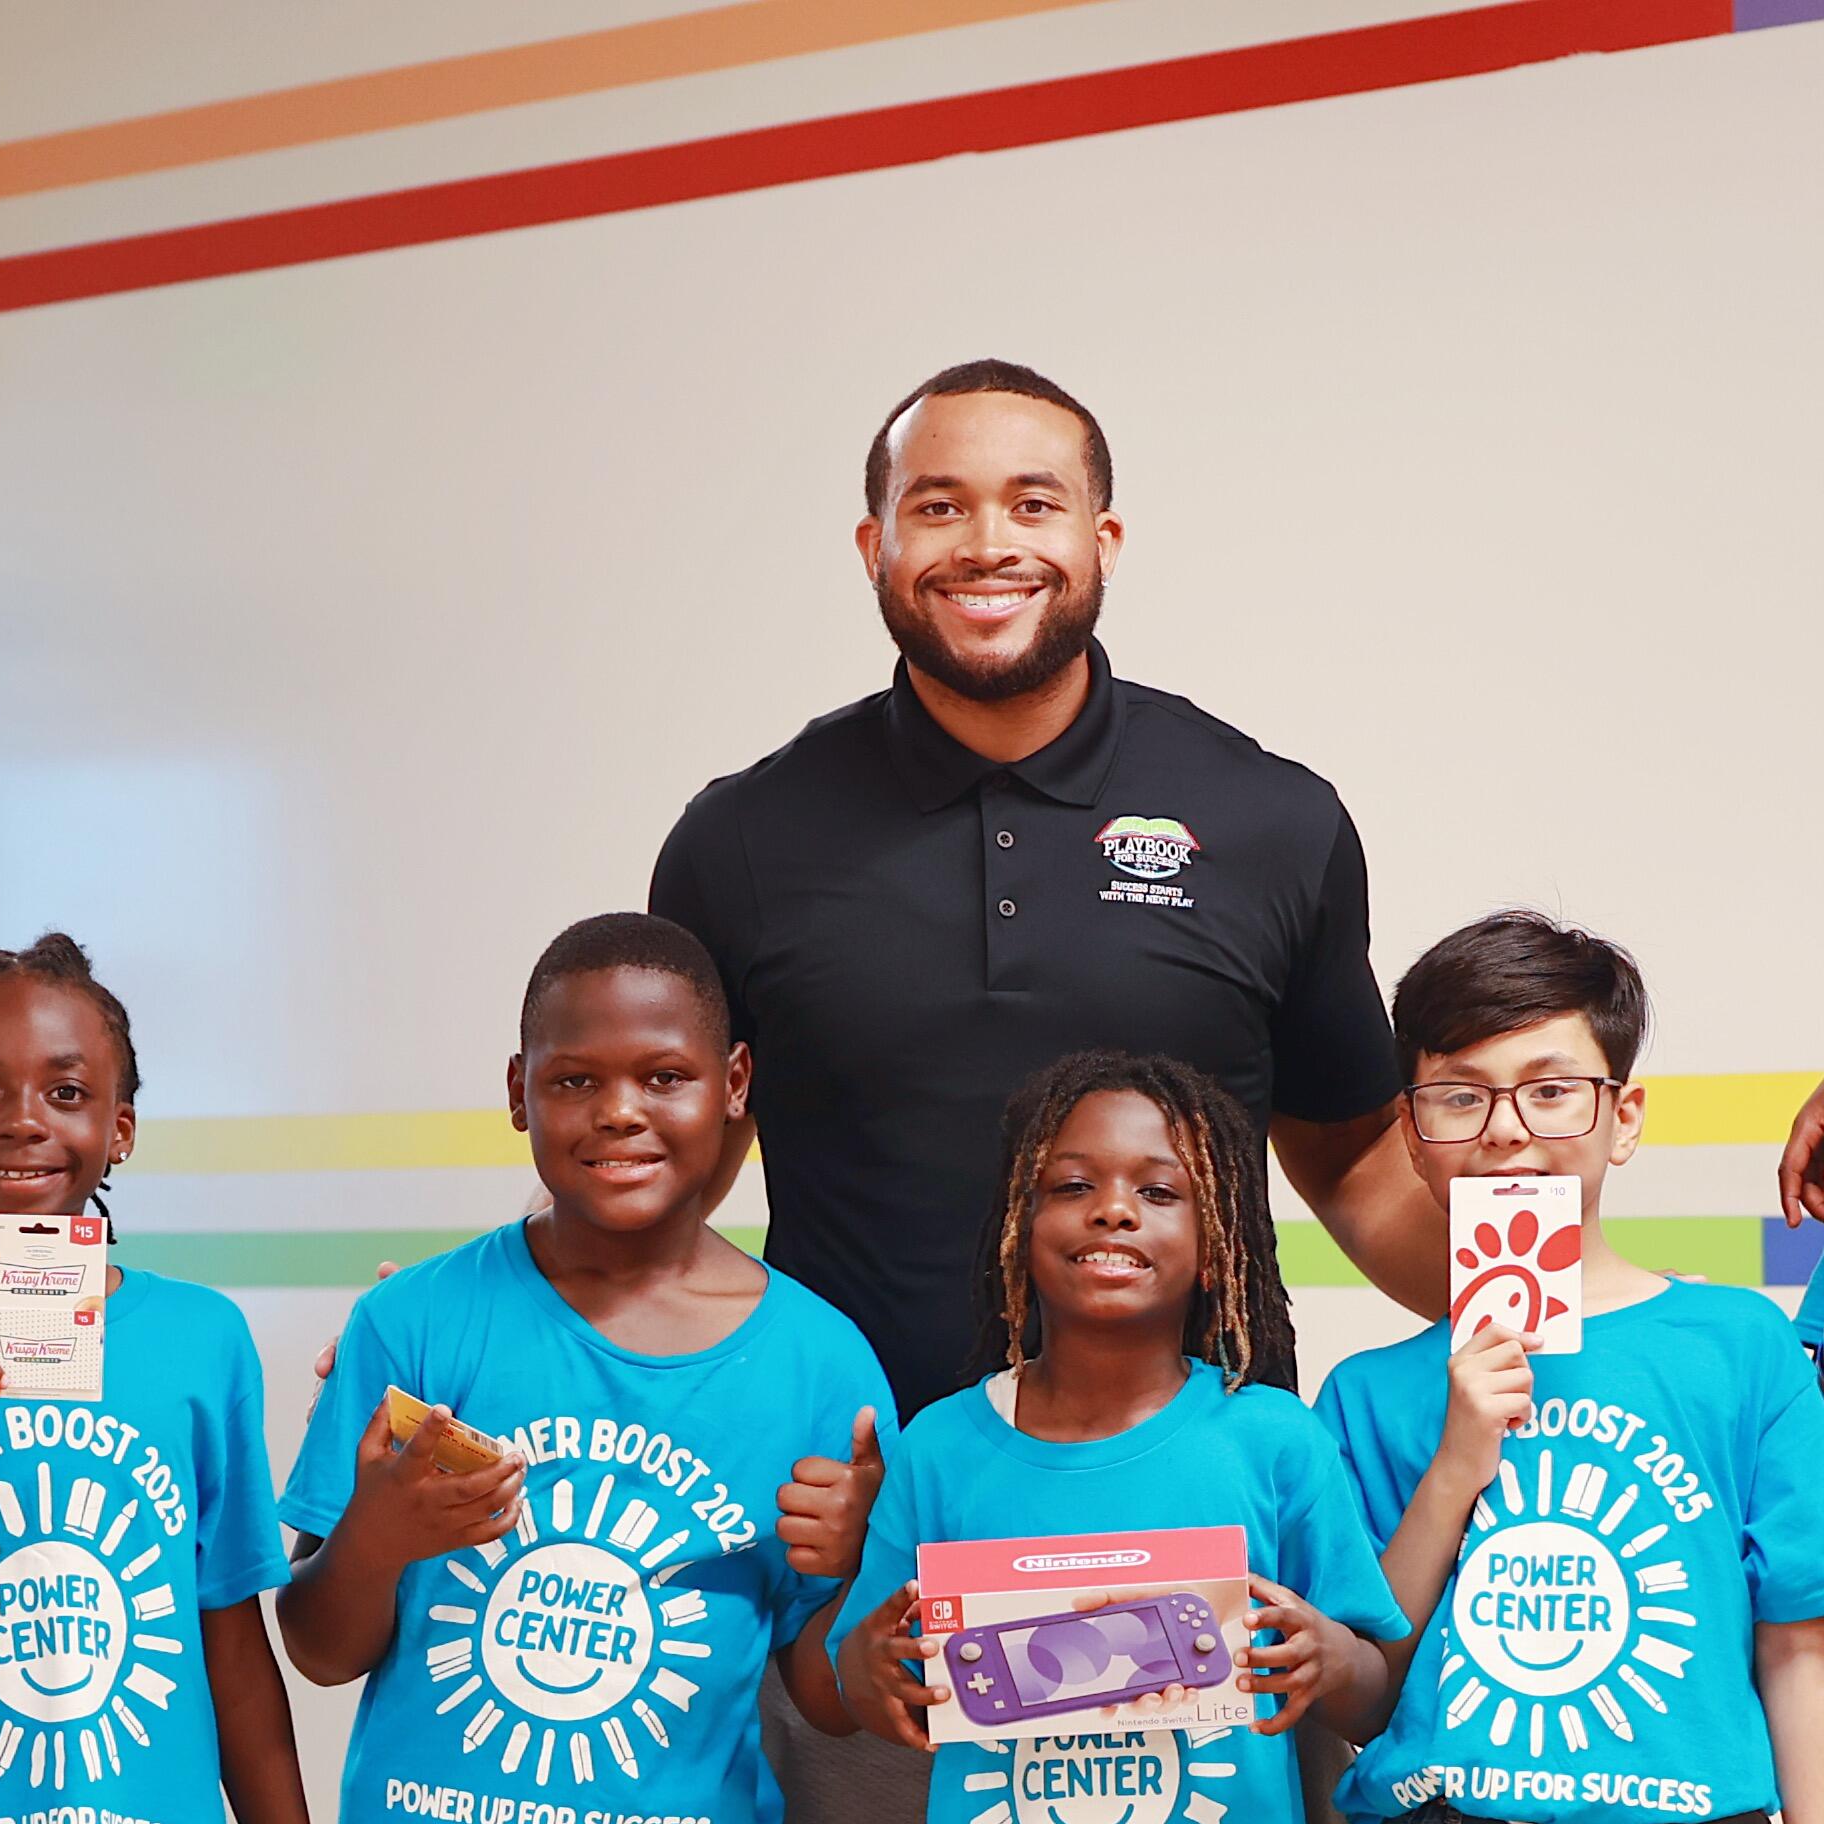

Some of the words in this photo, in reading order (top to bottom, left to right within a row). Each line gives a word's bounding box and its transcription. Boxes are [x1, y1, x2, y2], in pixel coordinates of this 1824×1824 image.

[1103, 837, 1192, 864] PLAYBOOK
[1114, 854, 1135, 863] FOR
[1136, 854, 1180, 869] SUCCESS
[1099, 891, 1125, 901] WITH
[1126, 892, 1145, 902] THE
[1145, 895, 1170, 905] NEXT
[1171, 897, 1194, 908] PLAY
[1111, 881, 1149, 893] SUCCESS
[1149, 884, 1183, 897] STARTS
[75, 1225, 94, 1239] $15
[1, 1270, 41, 1287] Krispy
[41, 1271, 80, 1287] Kreme
[5, 1405, 140, 1465] BOOST
[132, 1446, 187, 1536] 2025
[589, 1419, 710, 1497] BOOST
[1516, 1398, 1646, 1452] BOOST
[1633, 1435, 1713, 1522] 2025
[1026, 1553, 1138, 1569] Nintendo
[1488, 1553, 1597, 1588] POWER
[518, 1570, 628, 1617] POWER
[1470, 1592, 1612, 1633] CENTER
[494, 1609, 636, 1664] CENTER
[1117, 1716, 1160, 1728] Nintendo
[1162, 1715, 1193, 1725] Switch
[1196, 1703, 1249, 1722] Lite
[1023, 1756, 1162, 1801] CENTER
[1471, 1766, 1509, 1799] UP
[1514, 1771, 1575, 1801] FOR
[1581, 1773, 1711, 1816] SUCCESS
[386, 1778, 474, 1823] POWER
